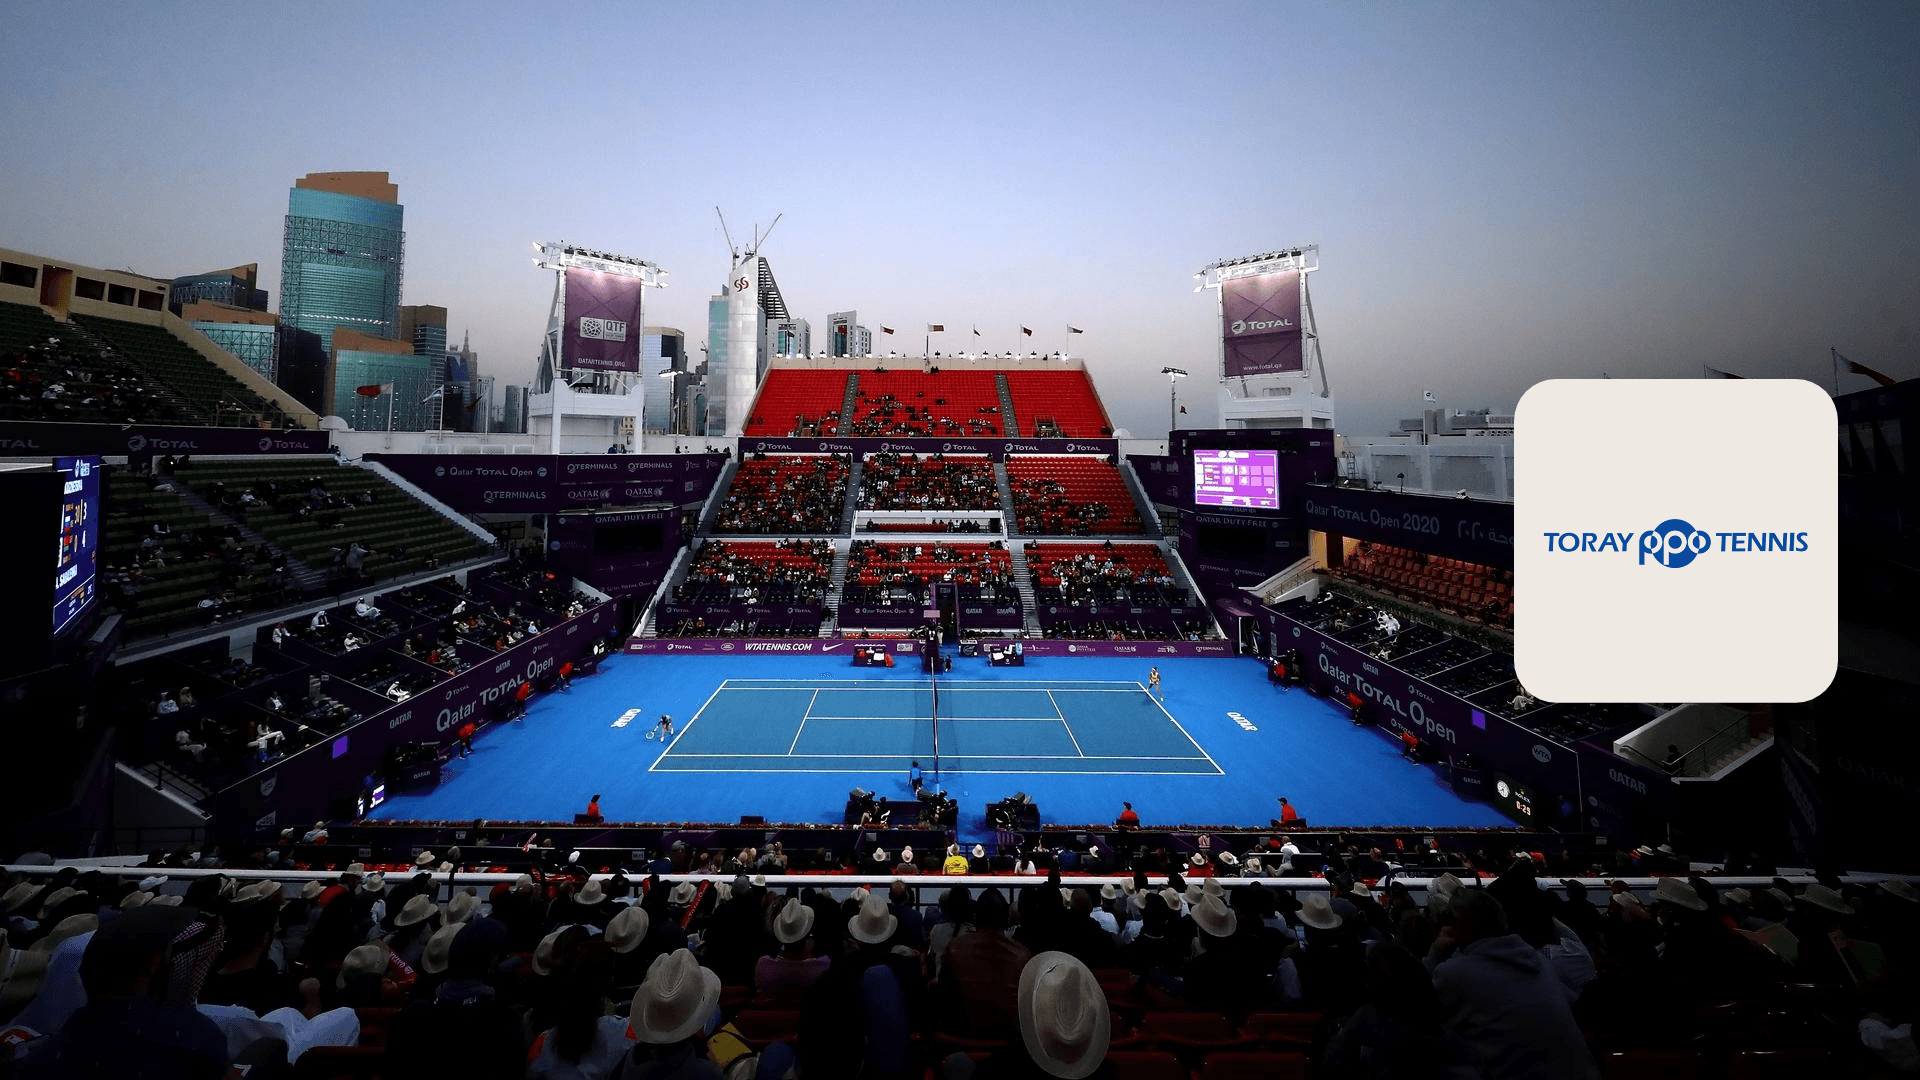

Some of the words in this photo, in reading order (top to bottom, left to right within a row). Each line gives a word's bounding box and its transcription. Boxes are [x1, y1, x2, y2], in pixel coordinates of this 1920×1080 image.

[605, 321, 625, 332] QTF
[1248, 318, 1293, 330] TOTAL
[148, 438, 199, 449] TOTAL
[272, 440, 310, 449] TOTAL
[828, 443, 854, 451] TOTAL
[449, 466, 474, 476] Qatar
[475, 467, 509, 476] TOTAL
[510, 466, 533, 477] Open
[568, 490, 599, 499] QATAR
[625, 488, 653, 497] QATAR
[1196, 516, 1221, 524] QATAR
[1305, 499, 1330, 517] Qatar
[1330, 504, 1368, 523] TOTAL
[1370, 509, 1400, 529] Open
[1402, 512, 1440, 535] 2020
[745, 643, 812, 651] WTATENNIS.COM
[436, 701, 477, 732] Qatar
[480, 674, 526, 706] TOTAL
[527, 657, 554, 679] Open
[1319, 653, 1351, 685] Qatar
[1353, 672, 1408, 718] TOTAL
[1410, 701, 1457, 745] Open
[1415, 688, 1436, 704] TOTAL
[389, 710, 413, 729] QATAR
[1608, 768, 1647, 796] QATAR
